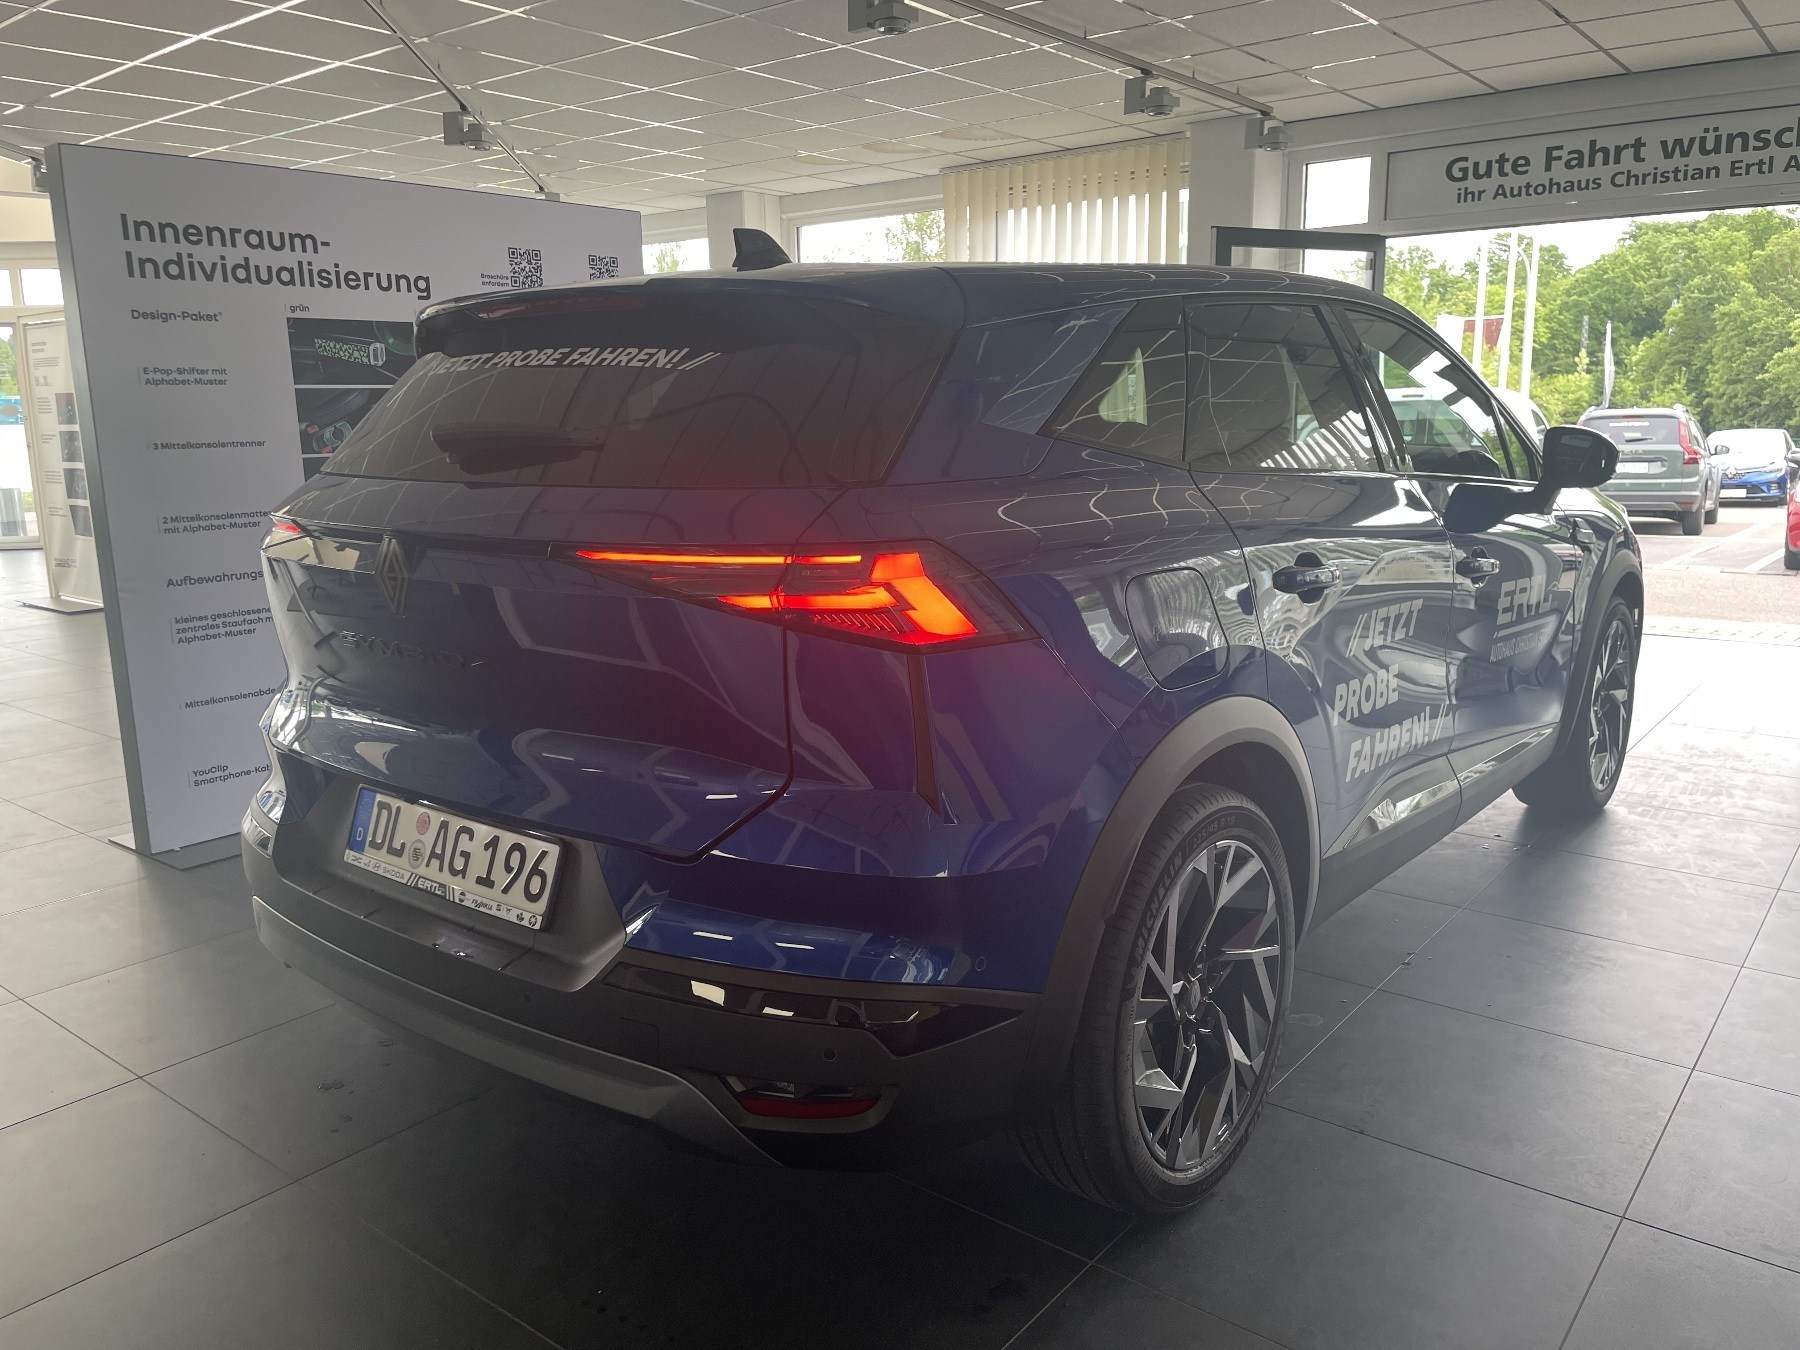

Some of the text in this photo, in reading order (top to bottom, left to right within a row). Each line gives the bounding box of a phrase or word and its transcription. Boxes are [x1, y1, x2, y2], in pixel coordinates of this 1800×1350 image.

[1445, 117, 1800, 183] Gute Fahrt wünsc
[1456, 187, 1486, 203] ihr
[1492, 177, 1602, 200] Autohaus
[1610, 163, 1721, 188] Christian
[1729, 155, 1775, 178] Ertl
[120, 213, 331, 254] Innenraum-
[125, 250, 431, 300] Individualisierung
[481, 280, 510, 288] anfordern
[289, 304, 310, 313] grün
[484, 349, 570, 369] PROBE
[564, 347, 690, 369] FAHREN!
[143, 367, 227, 377] E-Pop-Shifter mit
[144, 377, 228, 387] Alphabet-Muster
[152, 440, 266, 451] 3 Mittelkonsolentrenner
[162, 516, 168, 524] 2
[164, 520, 261, 534] mit Alphabet-Muster
[1497, 573, 1553, 625] ERTL
[175, 615, 209, 625] kleines
[176, 622, 221, 635] zentrales
[221, 616, 264, 628] Staufach
[1363, 598, 1424, 651] JETZT
[177, 627, 257, 645] Alphabet-Muster
[1333, 663, 1399, 726] PROBE
[1345, 705, 1430, 783] FAHREN!
[192, 764, 229, 778] YouClip
[356, 826, 363, 841] D
[368, 800, 406, 858] DL
